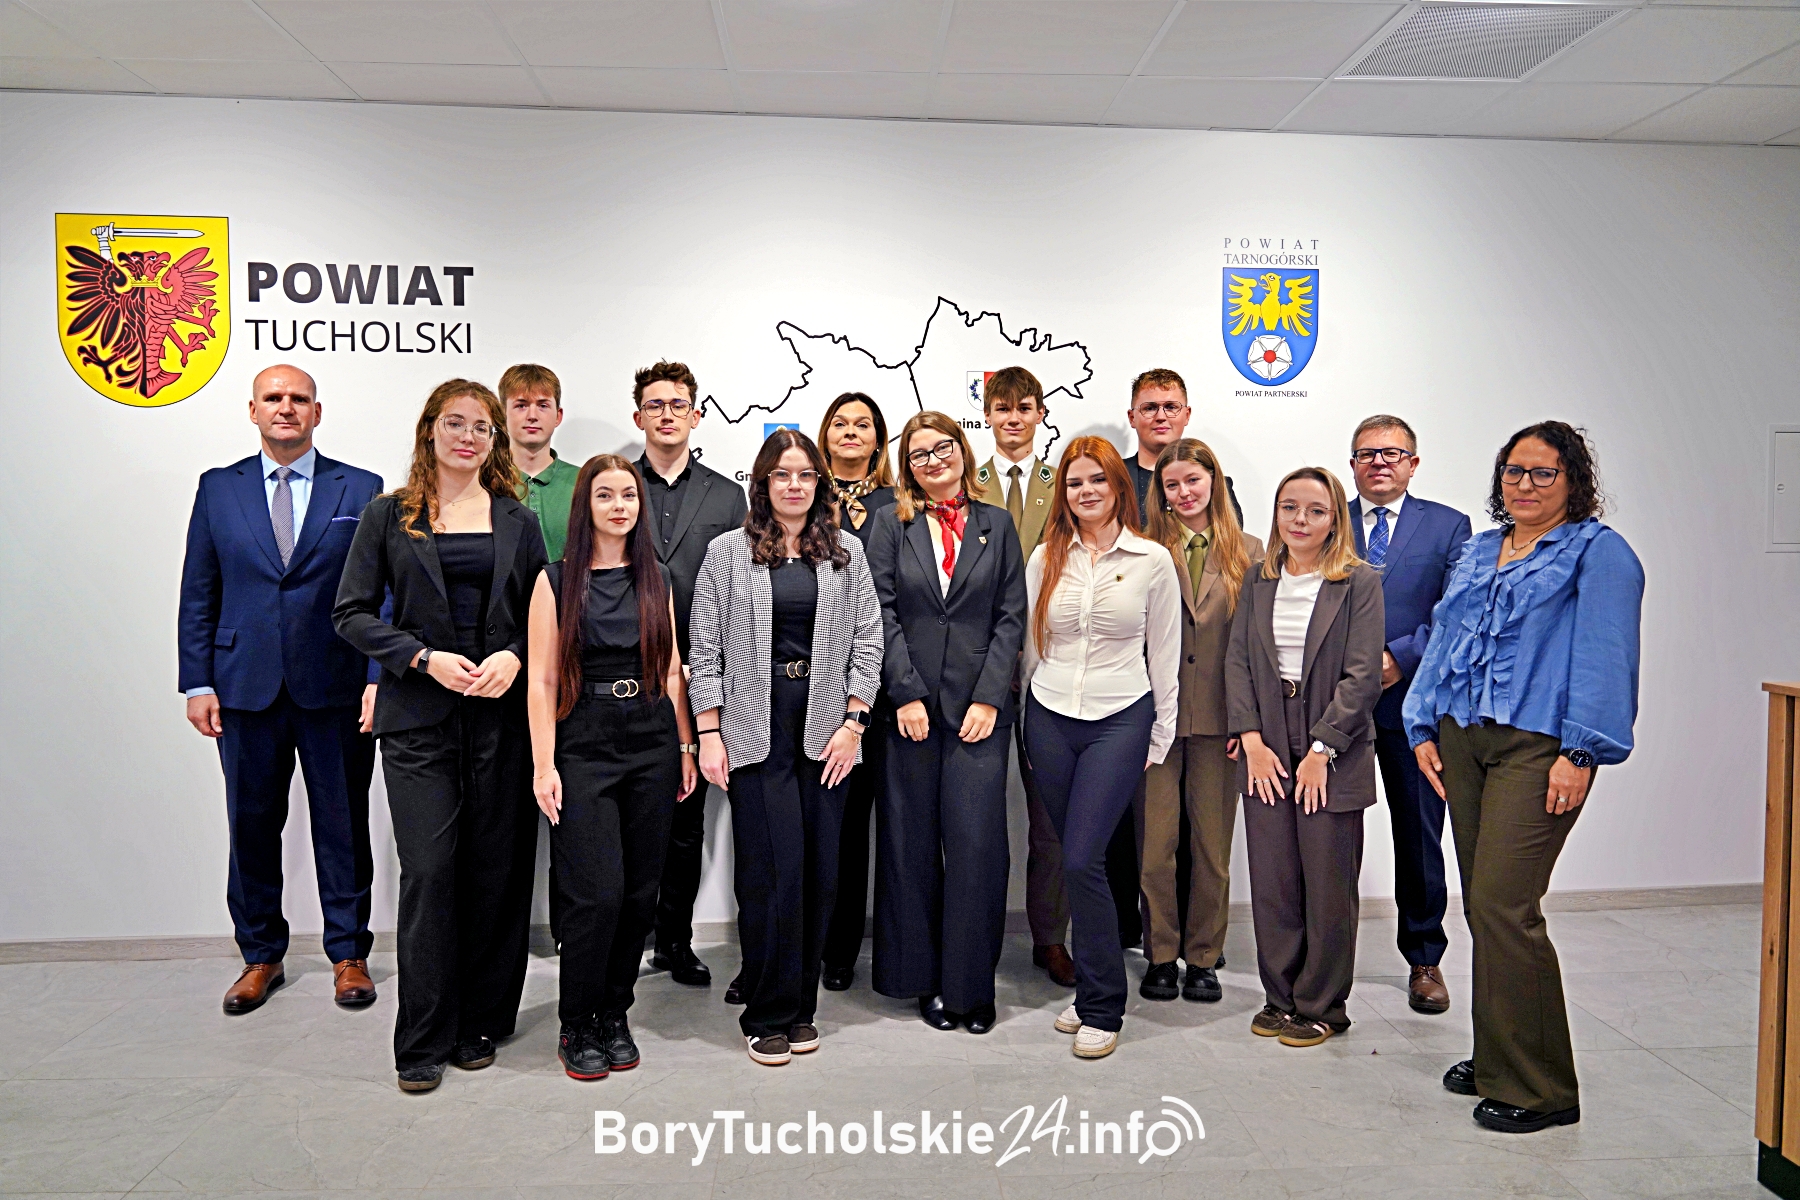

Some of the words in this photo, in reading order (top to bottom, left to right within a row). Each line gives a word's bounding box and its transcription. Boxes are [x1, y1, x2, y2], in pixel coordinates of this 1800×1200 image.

[1223, 237, 1319, 250] POWIAT
[1223, 251, 1319, 266] TARNOGÓRSKI
[247, 261, 474, 306] POWIAT
[244, 319, 472, 354] TUCHOLSKI
[1264, 390, 1308, 398] PARTNERSKI
